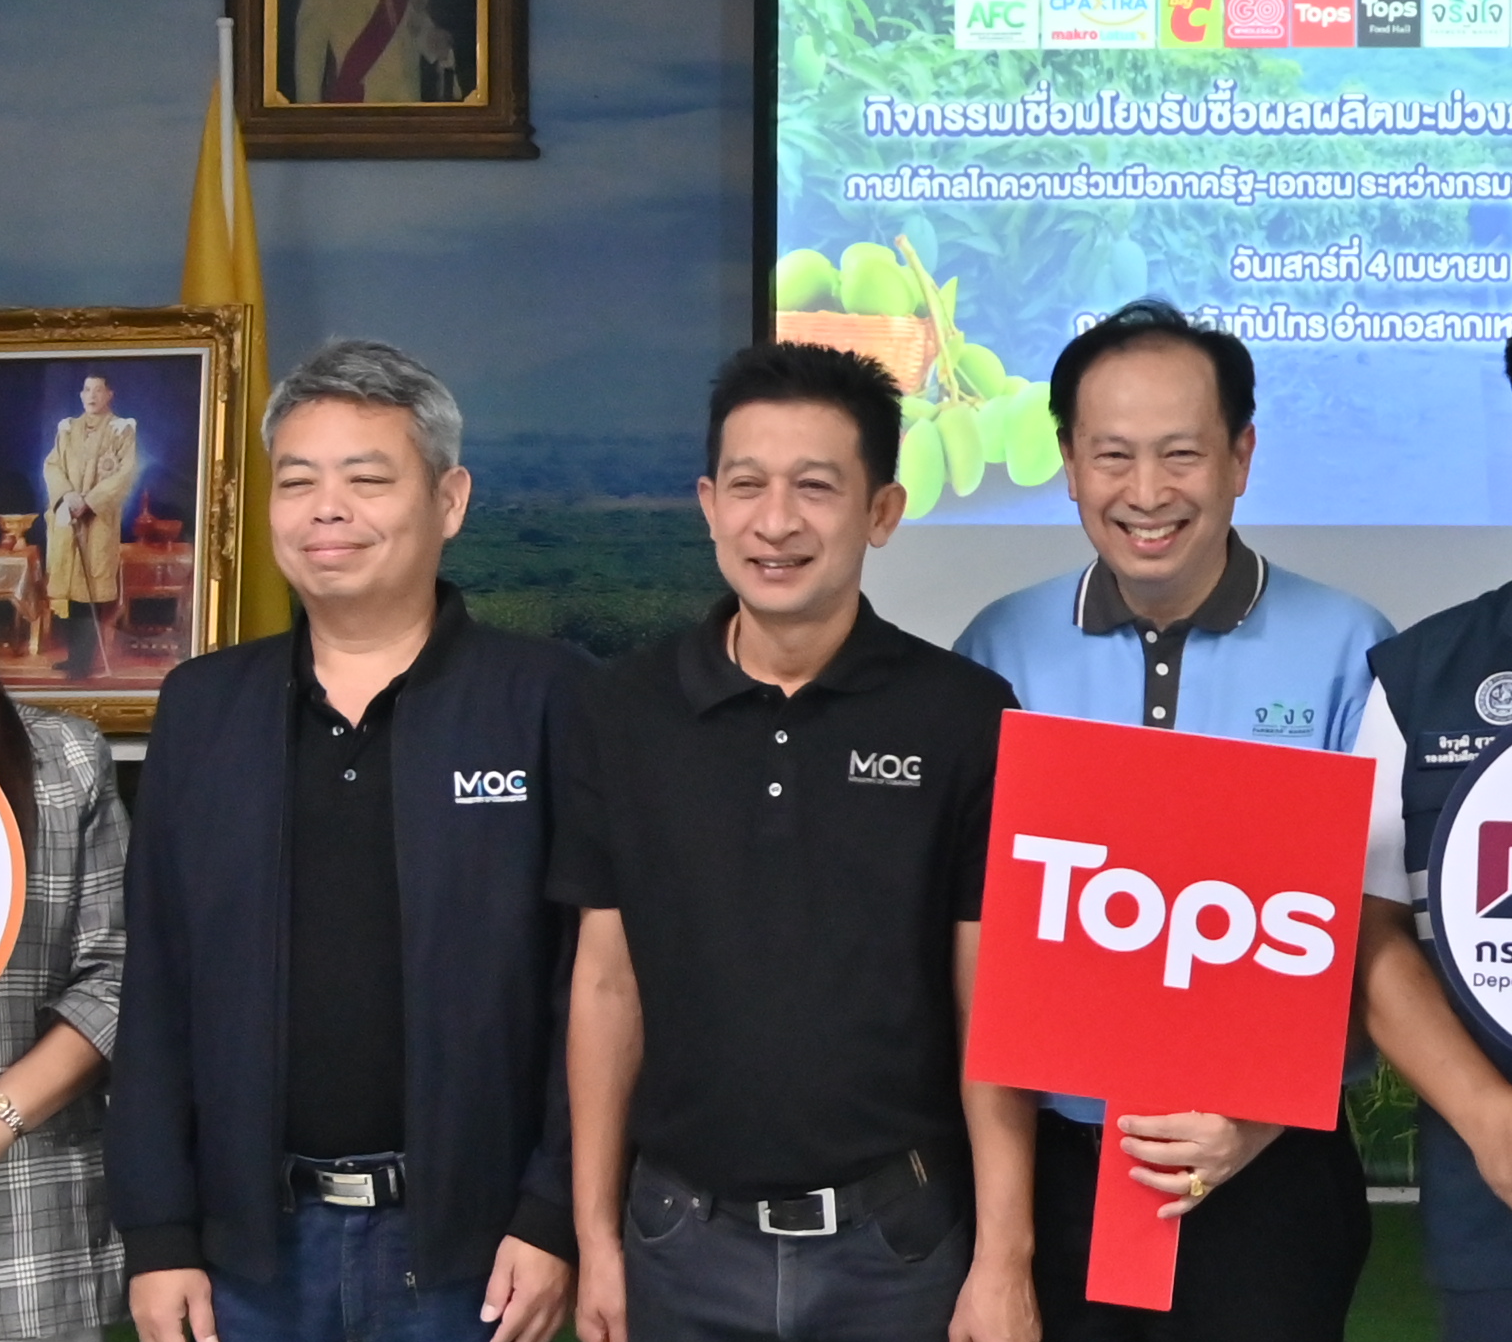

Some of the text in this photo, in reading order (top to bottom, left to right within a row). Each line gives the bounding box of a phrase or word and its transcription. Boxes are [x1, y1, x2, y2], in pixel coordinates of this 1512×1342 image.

[966, 0, 1027, 29] AFC
[1294, 2, 1352, 28] Tops
[1051, 27, 1099, 41] makro
[846, 166, 1353, 204] ภายใต้กลไกความร่วมมือภาครัฐ-เอกชน
[1232, 238, 1363, 281] วันเสาร์ที่
[1367, 252, 1388, 281] 4
[1394, 253, 1510, 282] เมษายน
[850, 748, 922, 781] MOC
[453, 769, 527, 797] MOC
[1011, 832, 1337, 991] Tops
